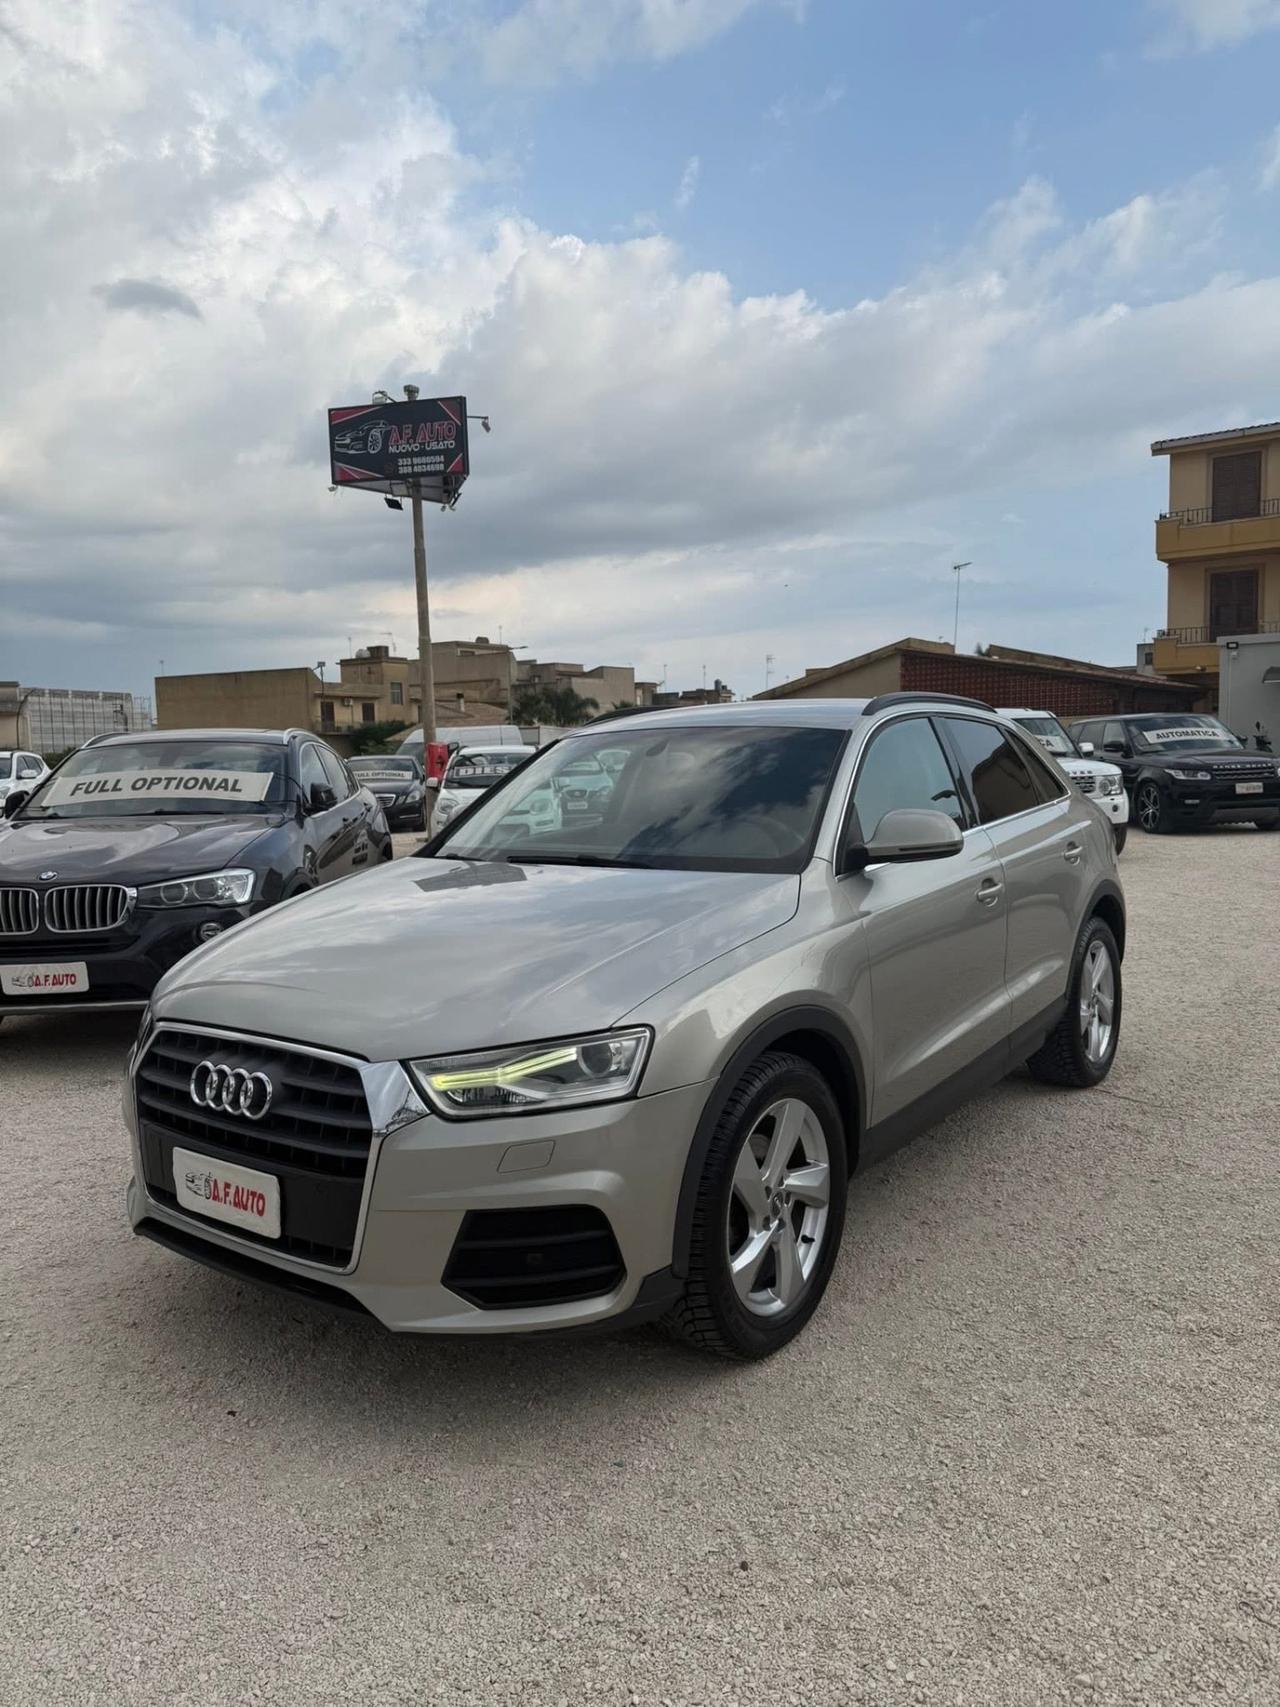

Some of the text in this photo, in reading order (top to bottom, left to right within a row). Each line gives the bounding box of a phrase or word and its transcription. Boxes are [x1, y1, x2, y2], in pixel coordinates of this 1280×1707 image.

[416, 421, 456, 443] AUTO
[388, 443, 420, 454] NUOVO
[425, 440, 456, 450] USATO
[1156, 729, 1220, 740] AUTOMATICA
[459, 766, 511, 776] DIES
[70, 776, 243, 796] FULL OPTIONAL
